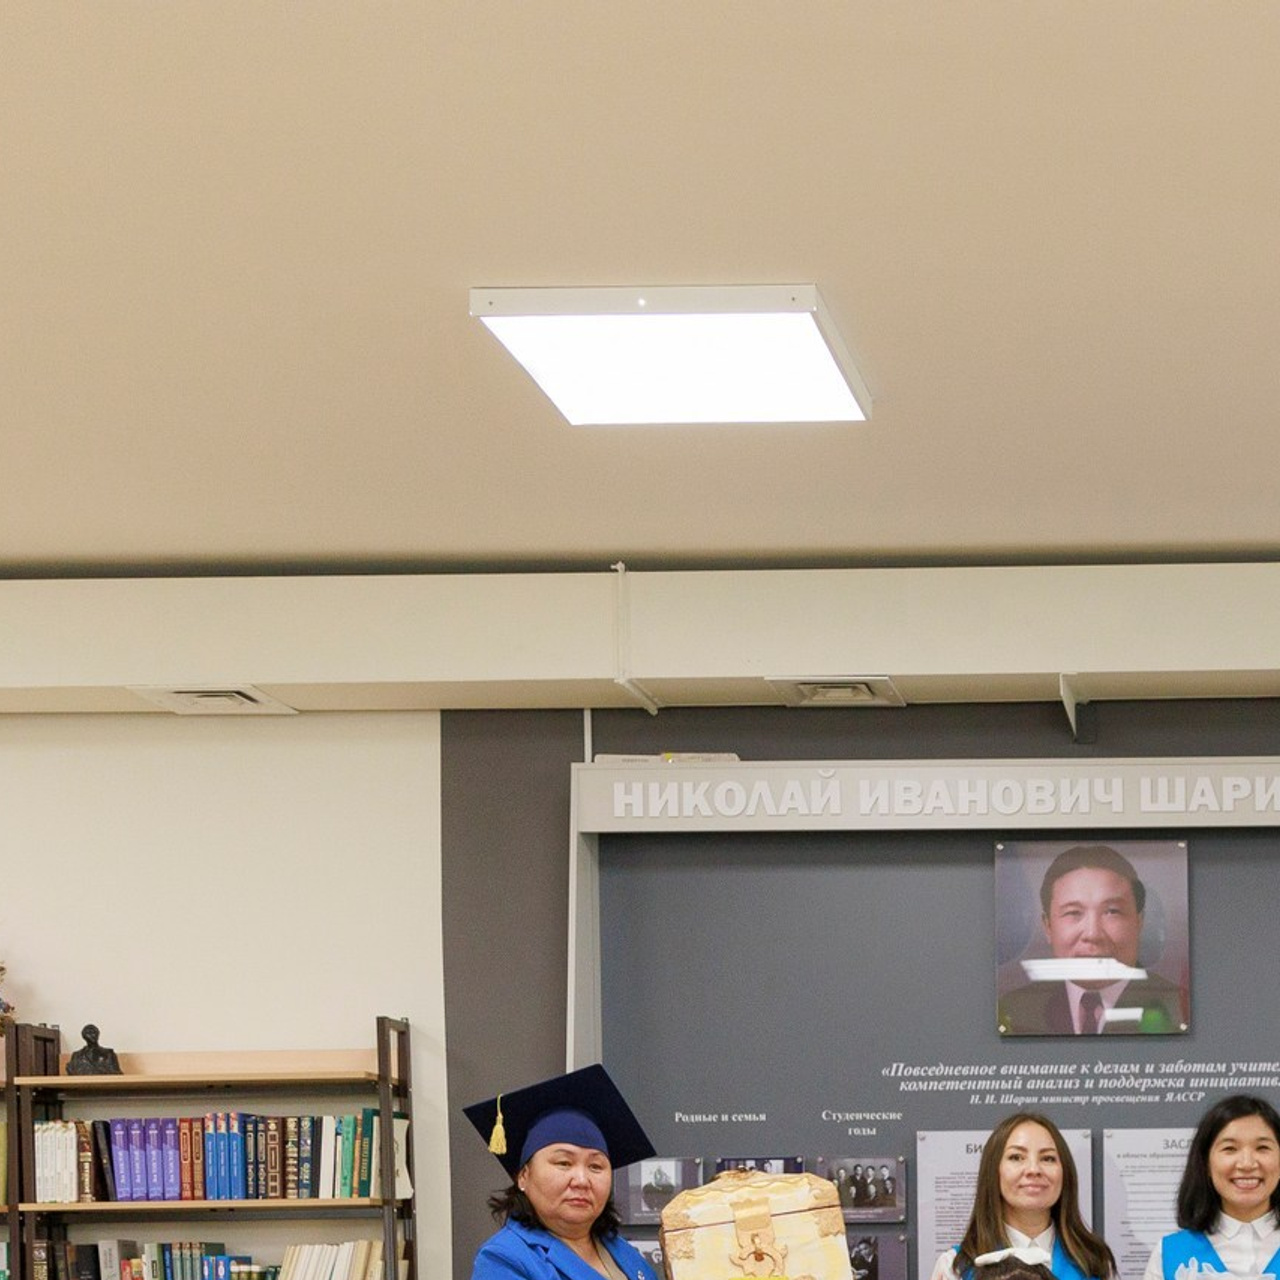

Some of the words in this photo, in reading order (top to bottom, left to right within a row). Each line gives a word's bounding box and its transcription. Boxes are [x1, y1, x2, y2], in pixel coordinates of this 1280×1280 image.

[613, 768, 842, 817] НИКОЛАЙ
[859, 778, 1124, 816] ИВАНОВИЧ
[881, 1062, 996, 1077] «Повседневное
[1000, 1063, 1077, 1076] внимание
[1080, 1064, 1090, 1075] к
[1094, 1061, 1140, 1074] делам
[1144, 1064, 1154, 1074] и
[1158, 1059, 1226, 1073] заботам
[900, 1076, 1022, 1091] компетентный
[1026, 1077, 1080, 1090] анализ
[1084, 1078, 1094, 1089] и
[1099, 1075, 1186, 1092] поддержка
[1000, 1094, 1038, 1107] Шарин
[1041, 1095, 1089, 1106] министр
[1091, 1094, 1161, 1106] просвещения
[1164, 1091, 1206, 1103] ЯАССР
[674, 1111, 718, 1123] Родные
[721, 1114, 729, 1122] и
[731, 1112, 767, 1122] семья
[821, 1110, 903, 1124] Студенческие
[848, 1126, 877, 1136] годы
